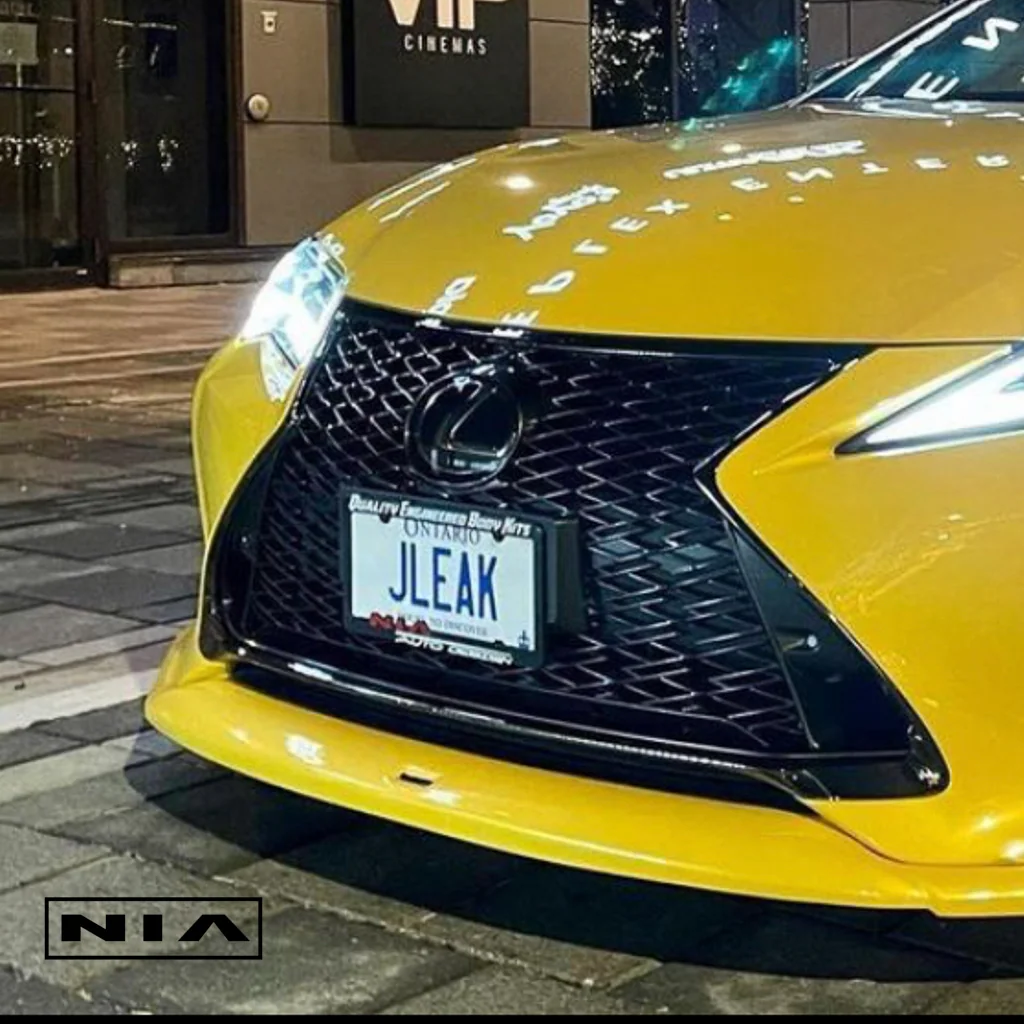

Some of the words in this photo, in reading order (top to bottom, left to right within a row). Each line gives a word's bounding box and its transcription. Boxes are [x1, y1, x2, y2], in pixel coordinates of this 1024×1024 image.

[403, 33, 488, 55] CINEMAS
[403, 518, 481, 546] ONTARIO
[388, 540, 498, 622] JLEAK
